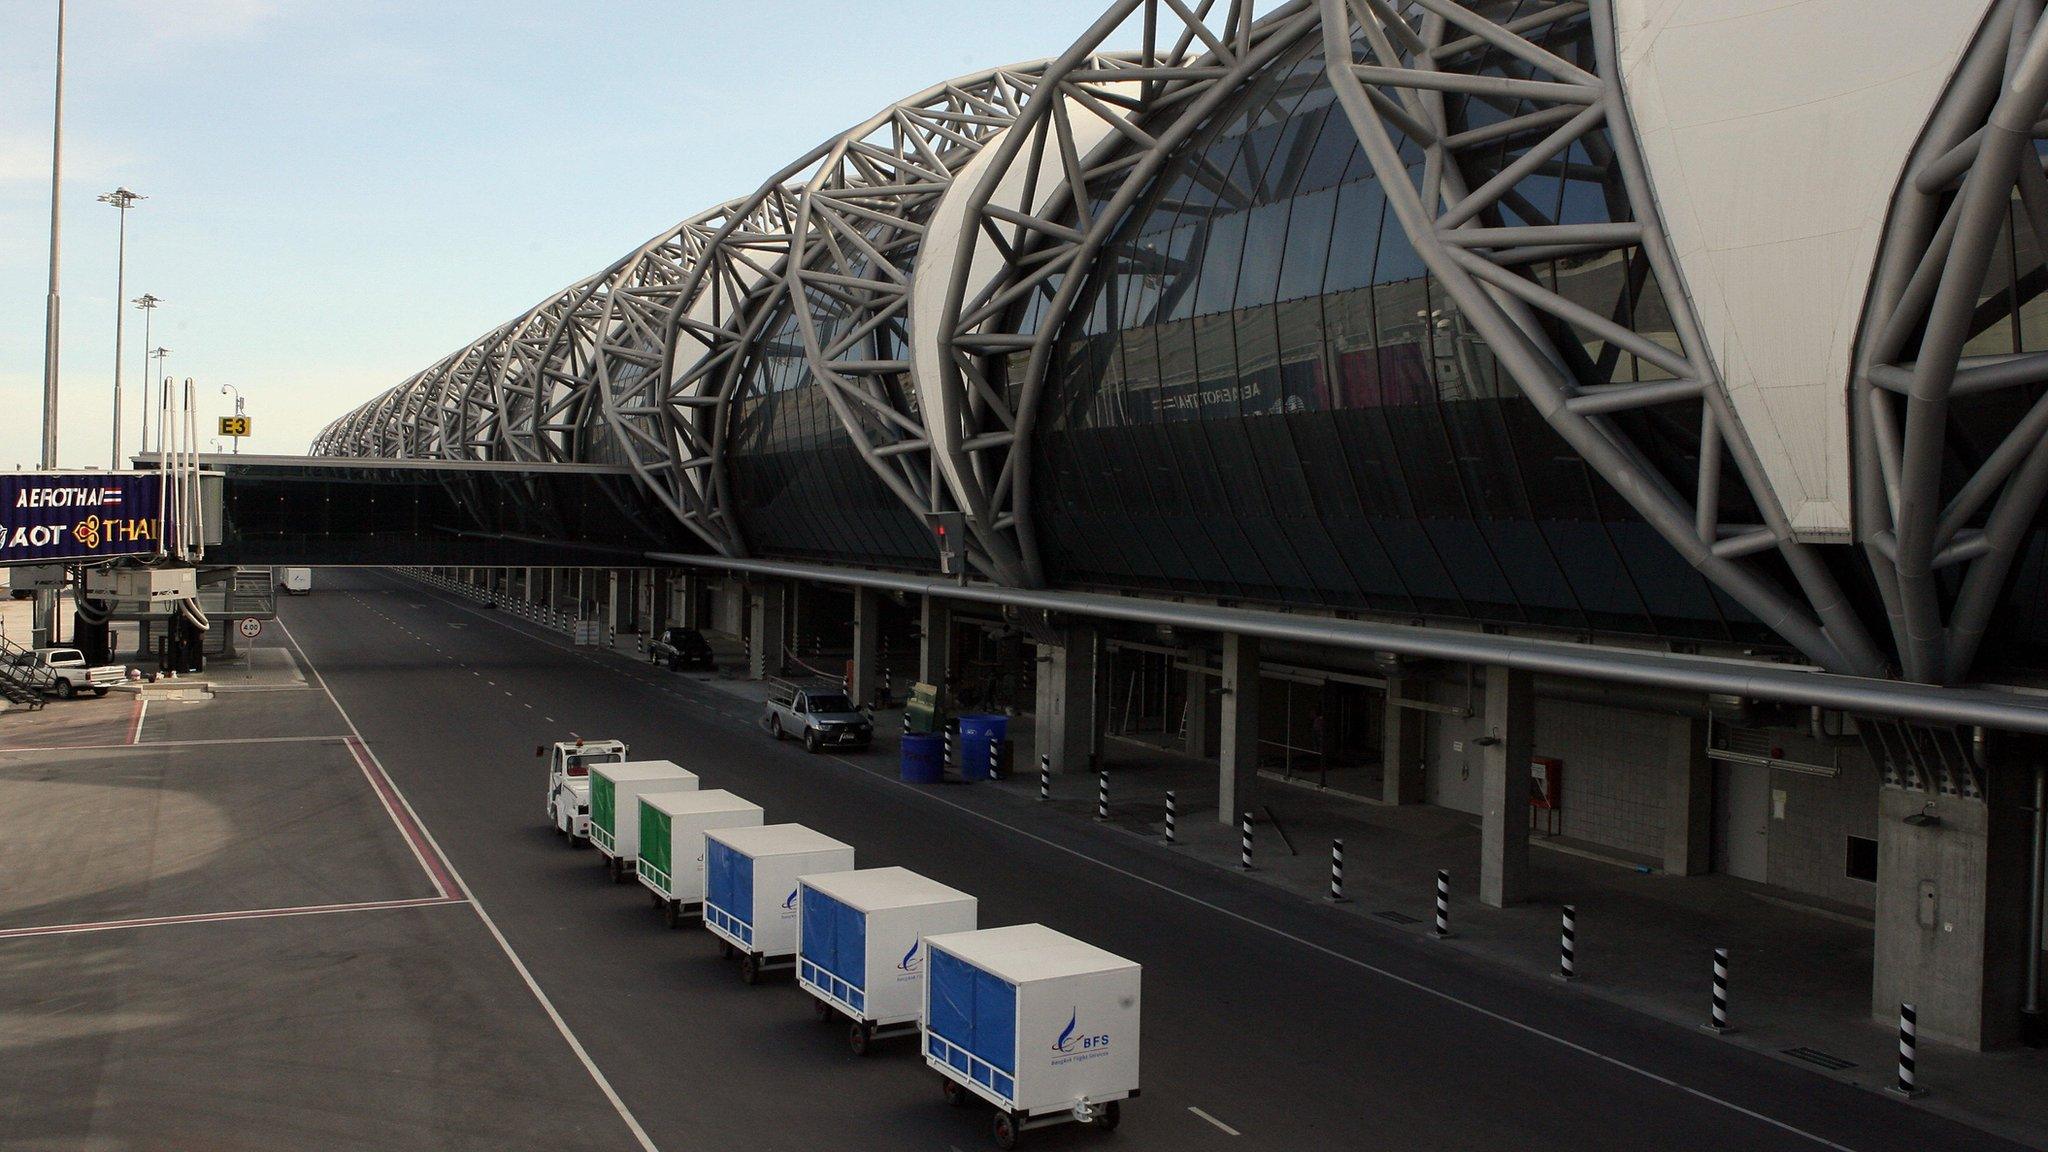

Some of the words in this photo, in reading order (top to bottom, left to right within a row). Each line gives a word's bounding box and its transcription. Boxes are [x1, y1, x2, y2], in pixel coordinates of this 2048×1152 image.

[223, 418, 246, 434] E3
[16, 487, 105, 508] AEROTHAI
[8, 525, 67, 547] AOT
[103, 518, 157, 542] THAI
[1084, 1034, 1109, 1048] BFS
